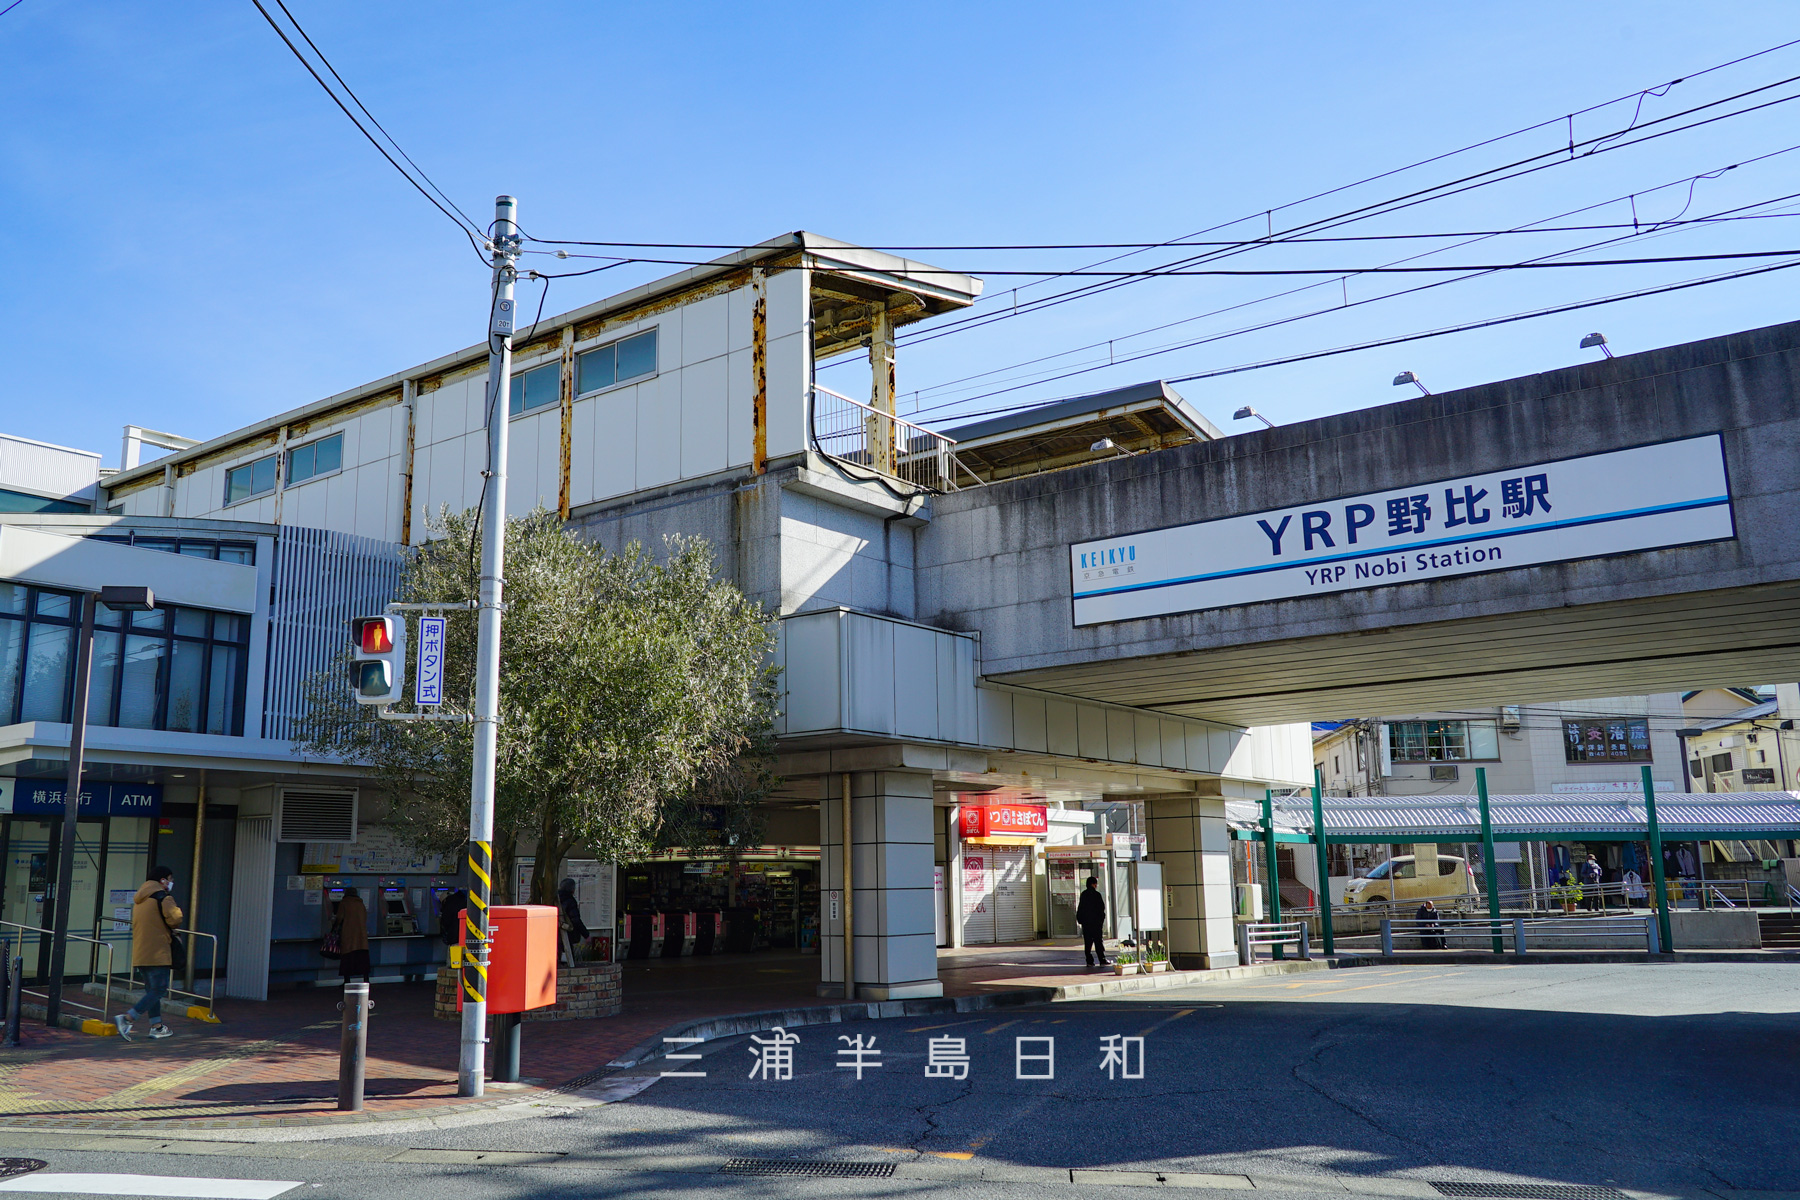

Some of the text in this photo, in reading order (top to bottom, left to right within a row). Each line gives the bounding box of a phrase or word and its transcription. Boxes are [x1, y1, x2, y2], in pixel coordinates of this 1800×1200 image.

[1256, 473, 1552, 555] YRP野比駅
[1081, 545, 1136, 569] KEIKYU
[1305, 546, 1502, 586] YRP Nobi Station
[422, 624, 440, 698] 押ボタン式
[32, 789, 92, 805] 横浜行
[121, 794, 152, 806] ATM
[990, 810, 1001, 823] つ
